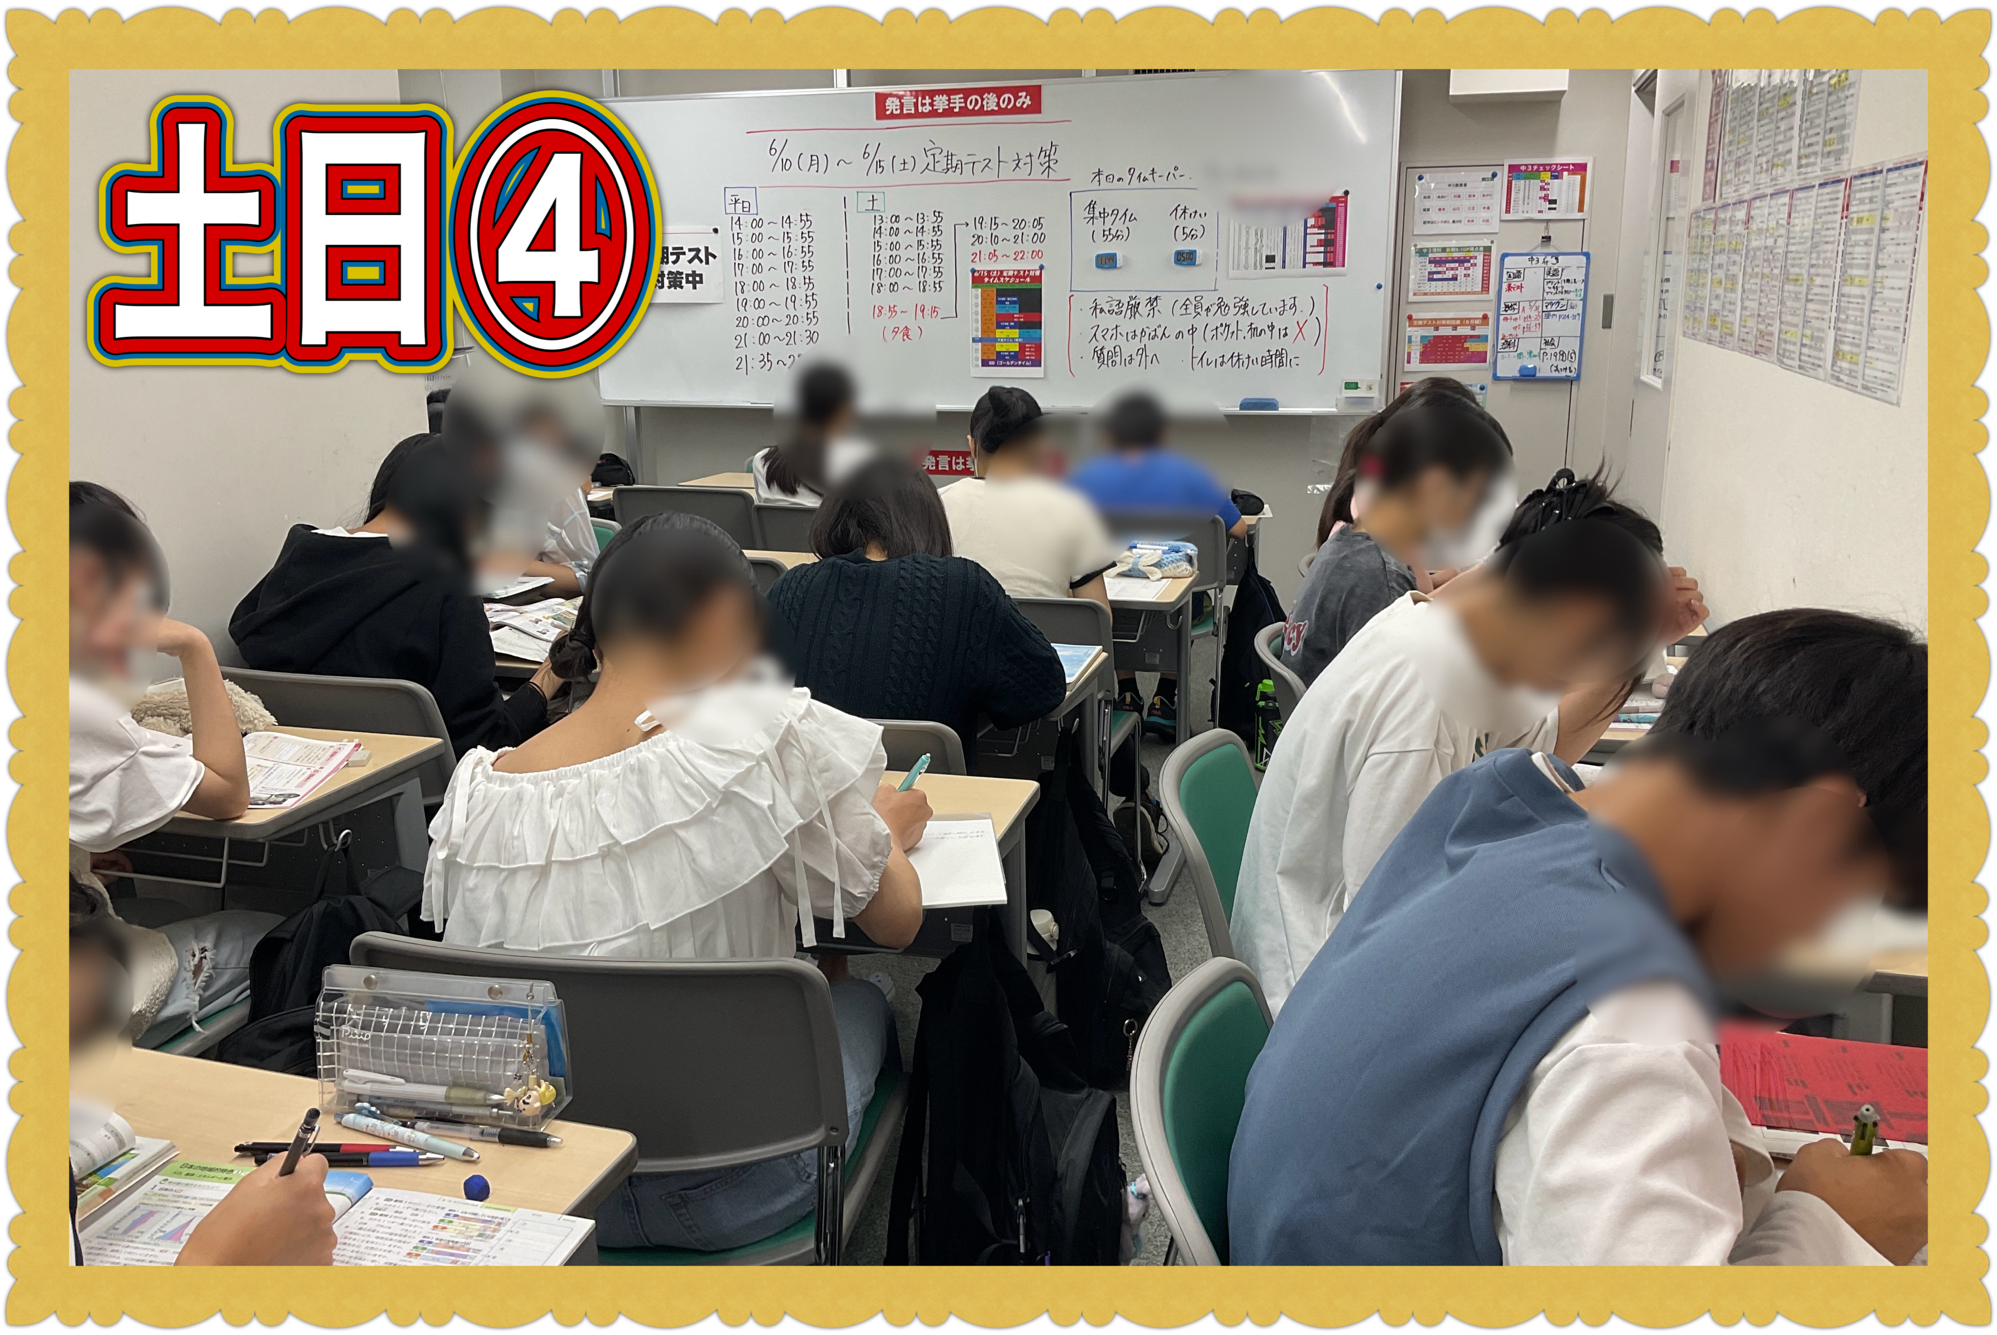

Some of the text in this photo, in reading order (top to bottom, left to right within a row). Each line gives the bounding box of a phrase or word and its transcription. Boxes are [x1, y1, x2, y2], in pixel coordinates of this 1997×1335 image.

[885, 91, 1032, 115] 発言は挙手の後のみ
[728, 194, 751, 214] 平日
[865, 194, 881, 211] 土
[1083, 199, 1138, 226] 集中タイム
[1169, 203, 1207, 221] 休けい
[882, 325, 923, 342] (夕食)
[1091, 343, 1160, 370] 質問は外へ
[1191, 346, 1300, 371] トイレは休けい時間に
